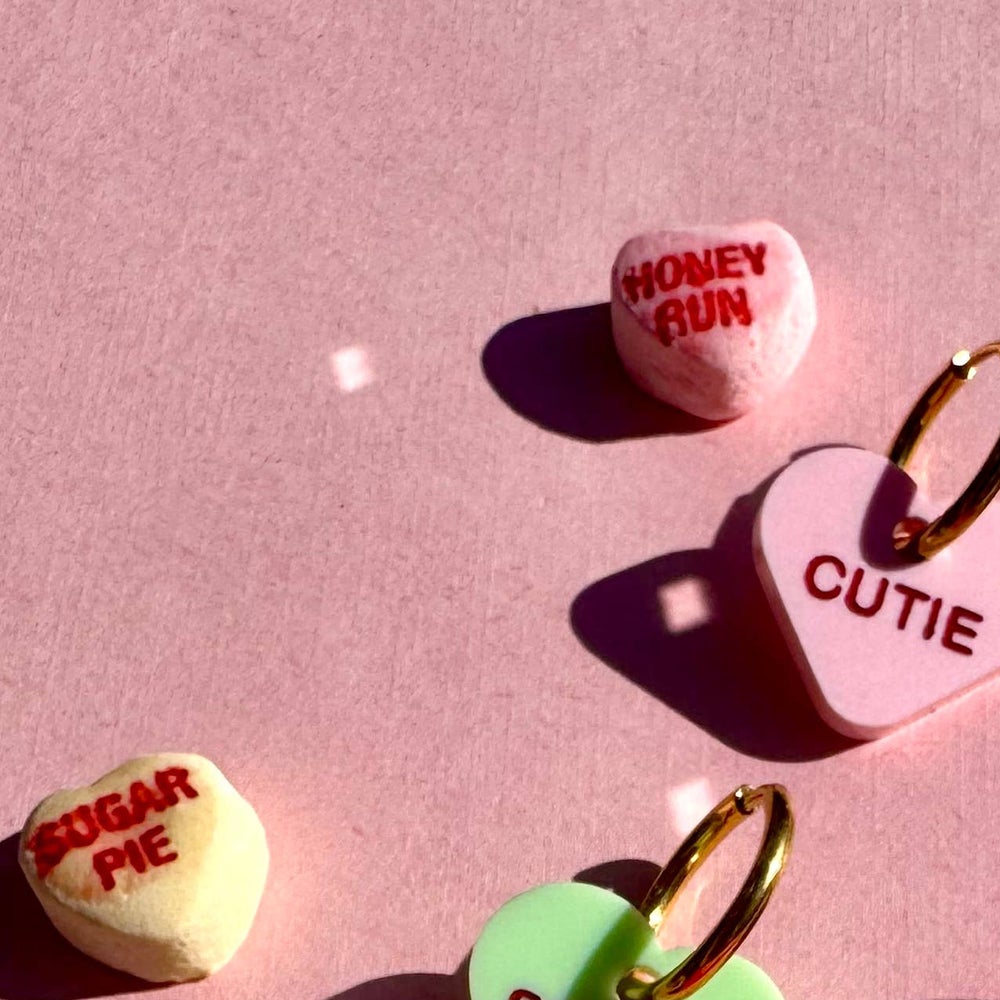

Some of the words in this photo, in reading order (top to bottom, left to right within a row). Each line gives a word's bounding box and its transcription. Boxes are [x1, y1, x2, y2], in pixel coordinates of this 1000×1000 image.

[622, 241, 767, 304] HONEY
[804, 555, 984, 656] CUTIE
[27, 766, 200, 880] SUGAR
[92, 824, 178, 892] PIE
